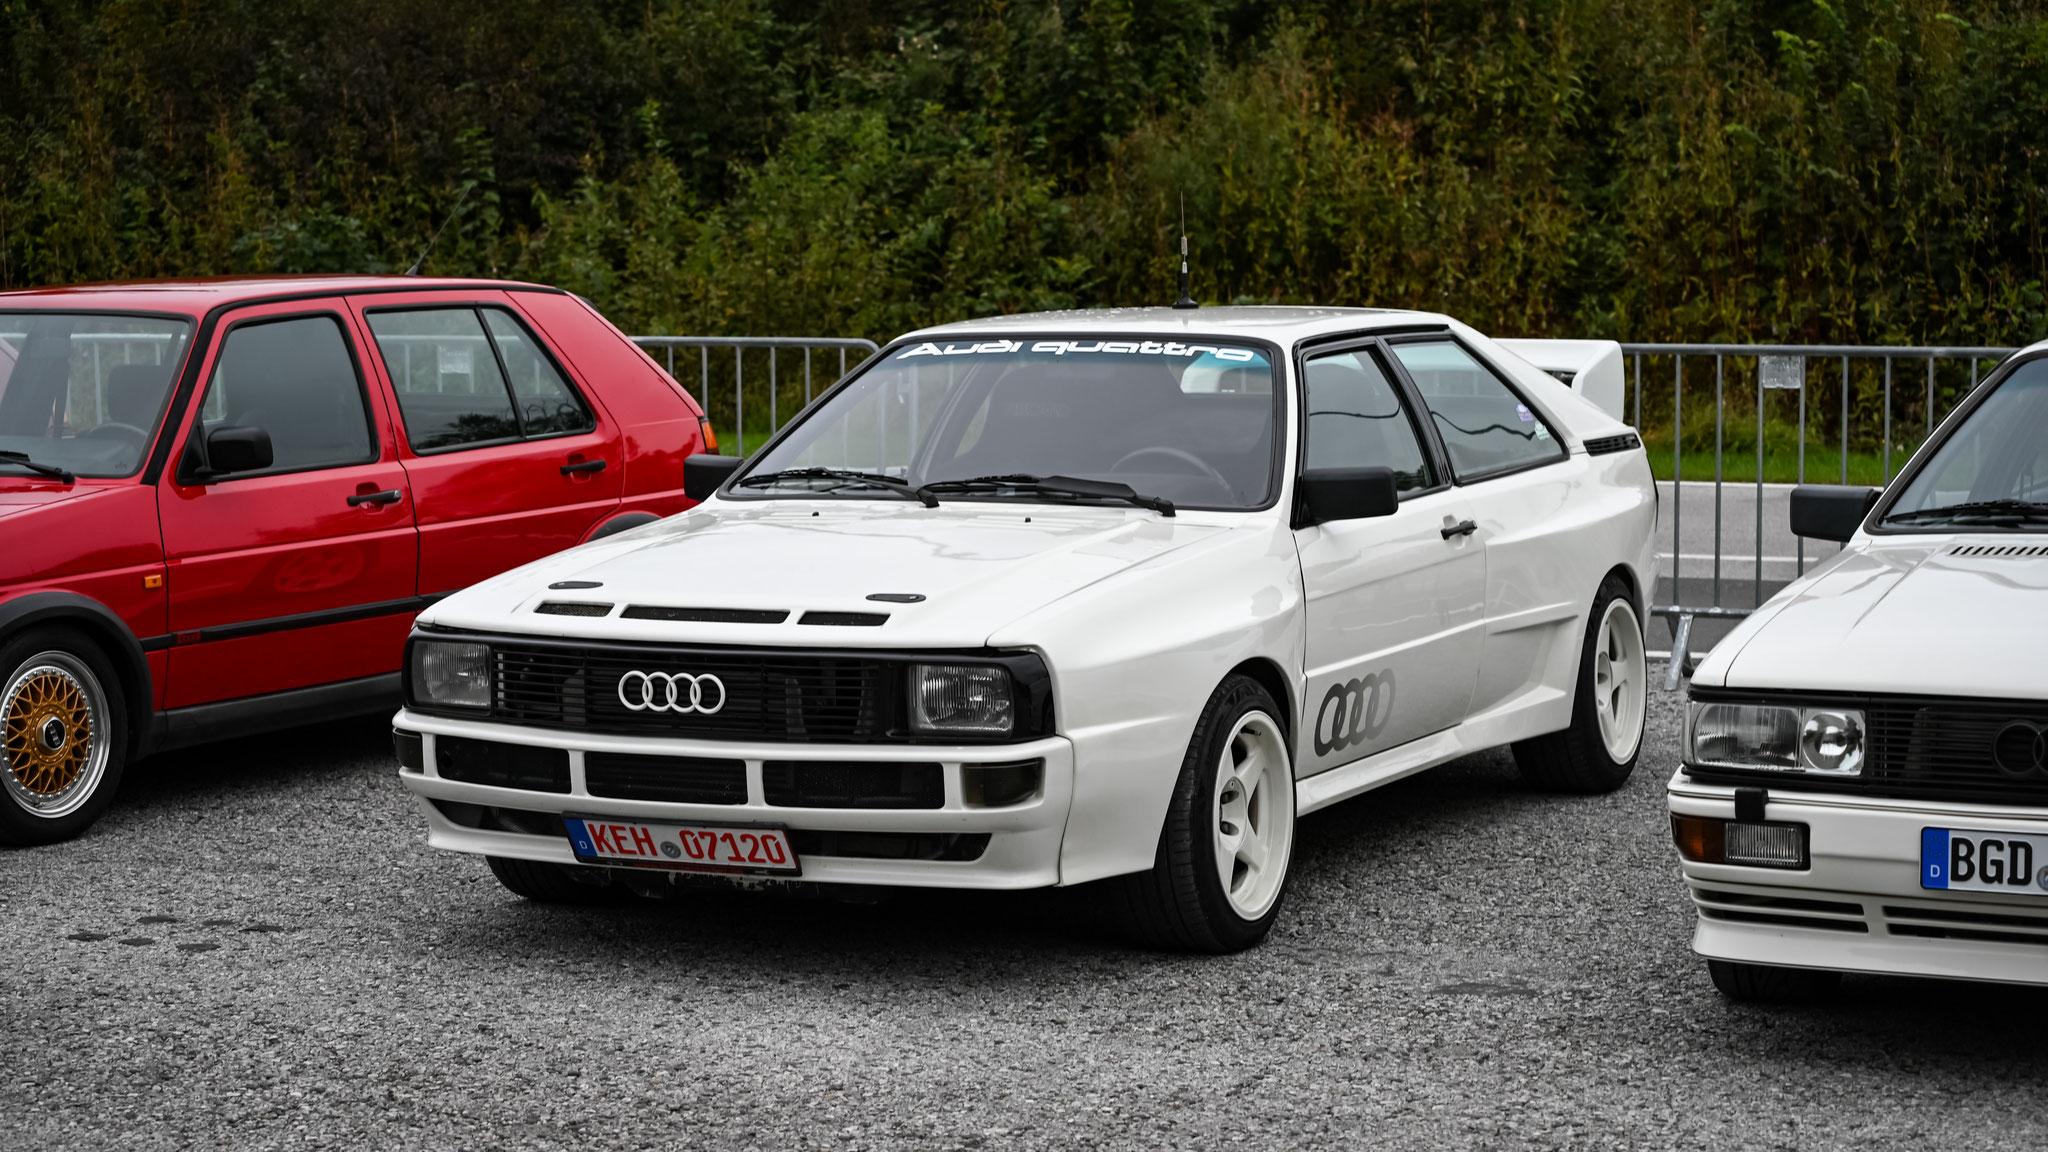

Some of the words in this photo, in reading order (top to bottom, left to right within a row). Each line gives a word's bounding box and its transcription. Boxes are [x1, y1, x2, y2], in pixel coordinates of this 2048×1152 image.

[896, 339, 1023, 359] Audi
[1031, 341, 1253, 361] quattro
[579, 840, 588, 849] D
[588, 823, 658, 856] KEH
[679, 830, 786, 864] 07120
[1930, 864, 1941, 877] D
[1951, 837, 2033, 886] BGD
